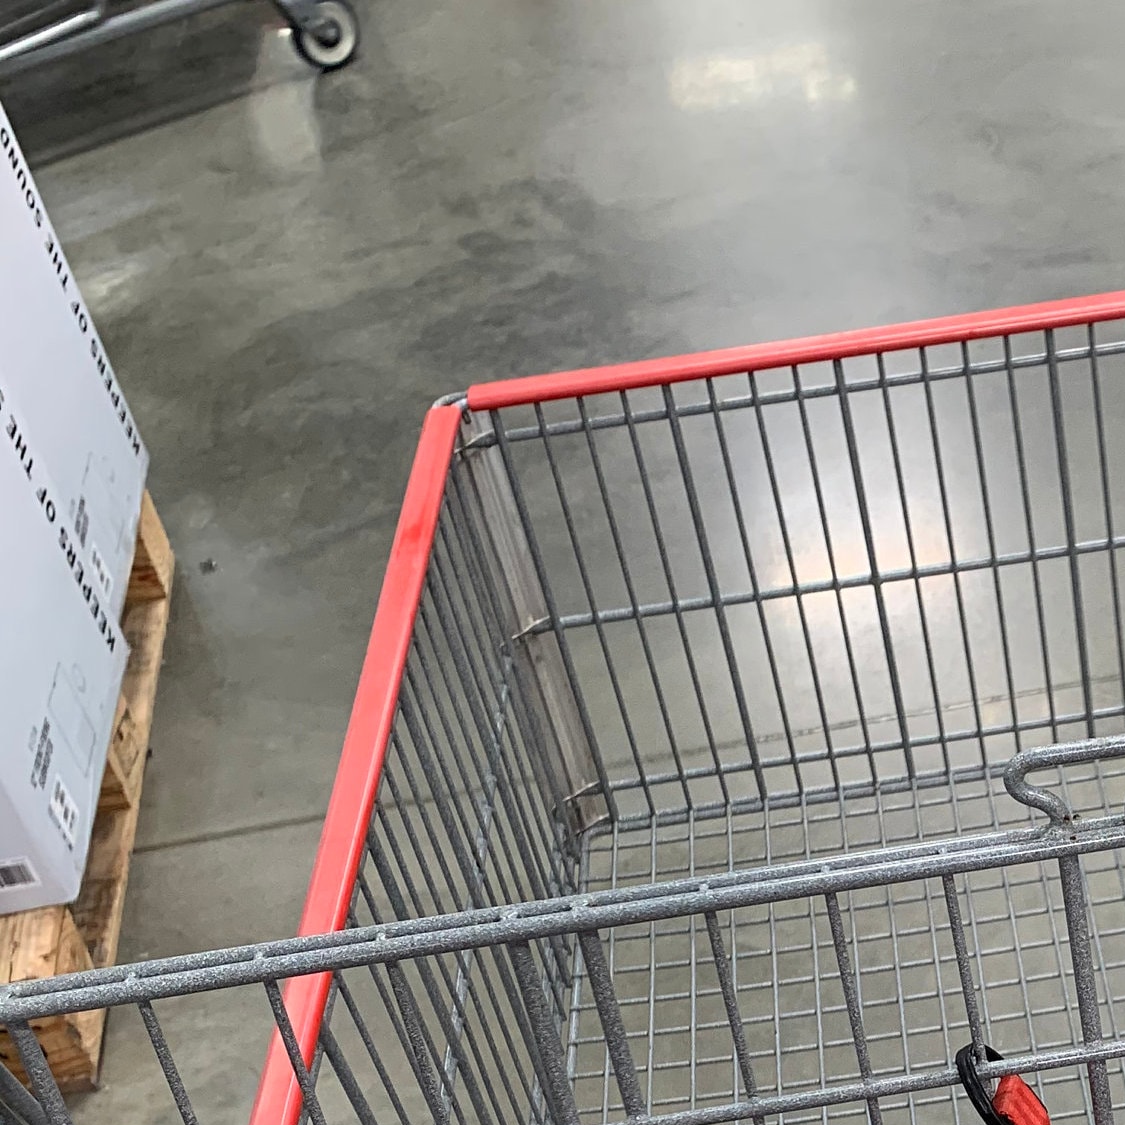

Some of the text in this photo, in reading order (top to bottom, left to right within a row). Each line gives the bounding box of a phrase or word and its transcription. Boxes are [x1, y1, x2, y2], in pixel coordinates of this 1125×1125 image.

[0, 126, 142, 456] KEEPERS OF THE SOUND
[5, 414, 34, 481] THE
[36, 487, 57, 523] OF
[58, 525, 116, 653] KEEPERS
